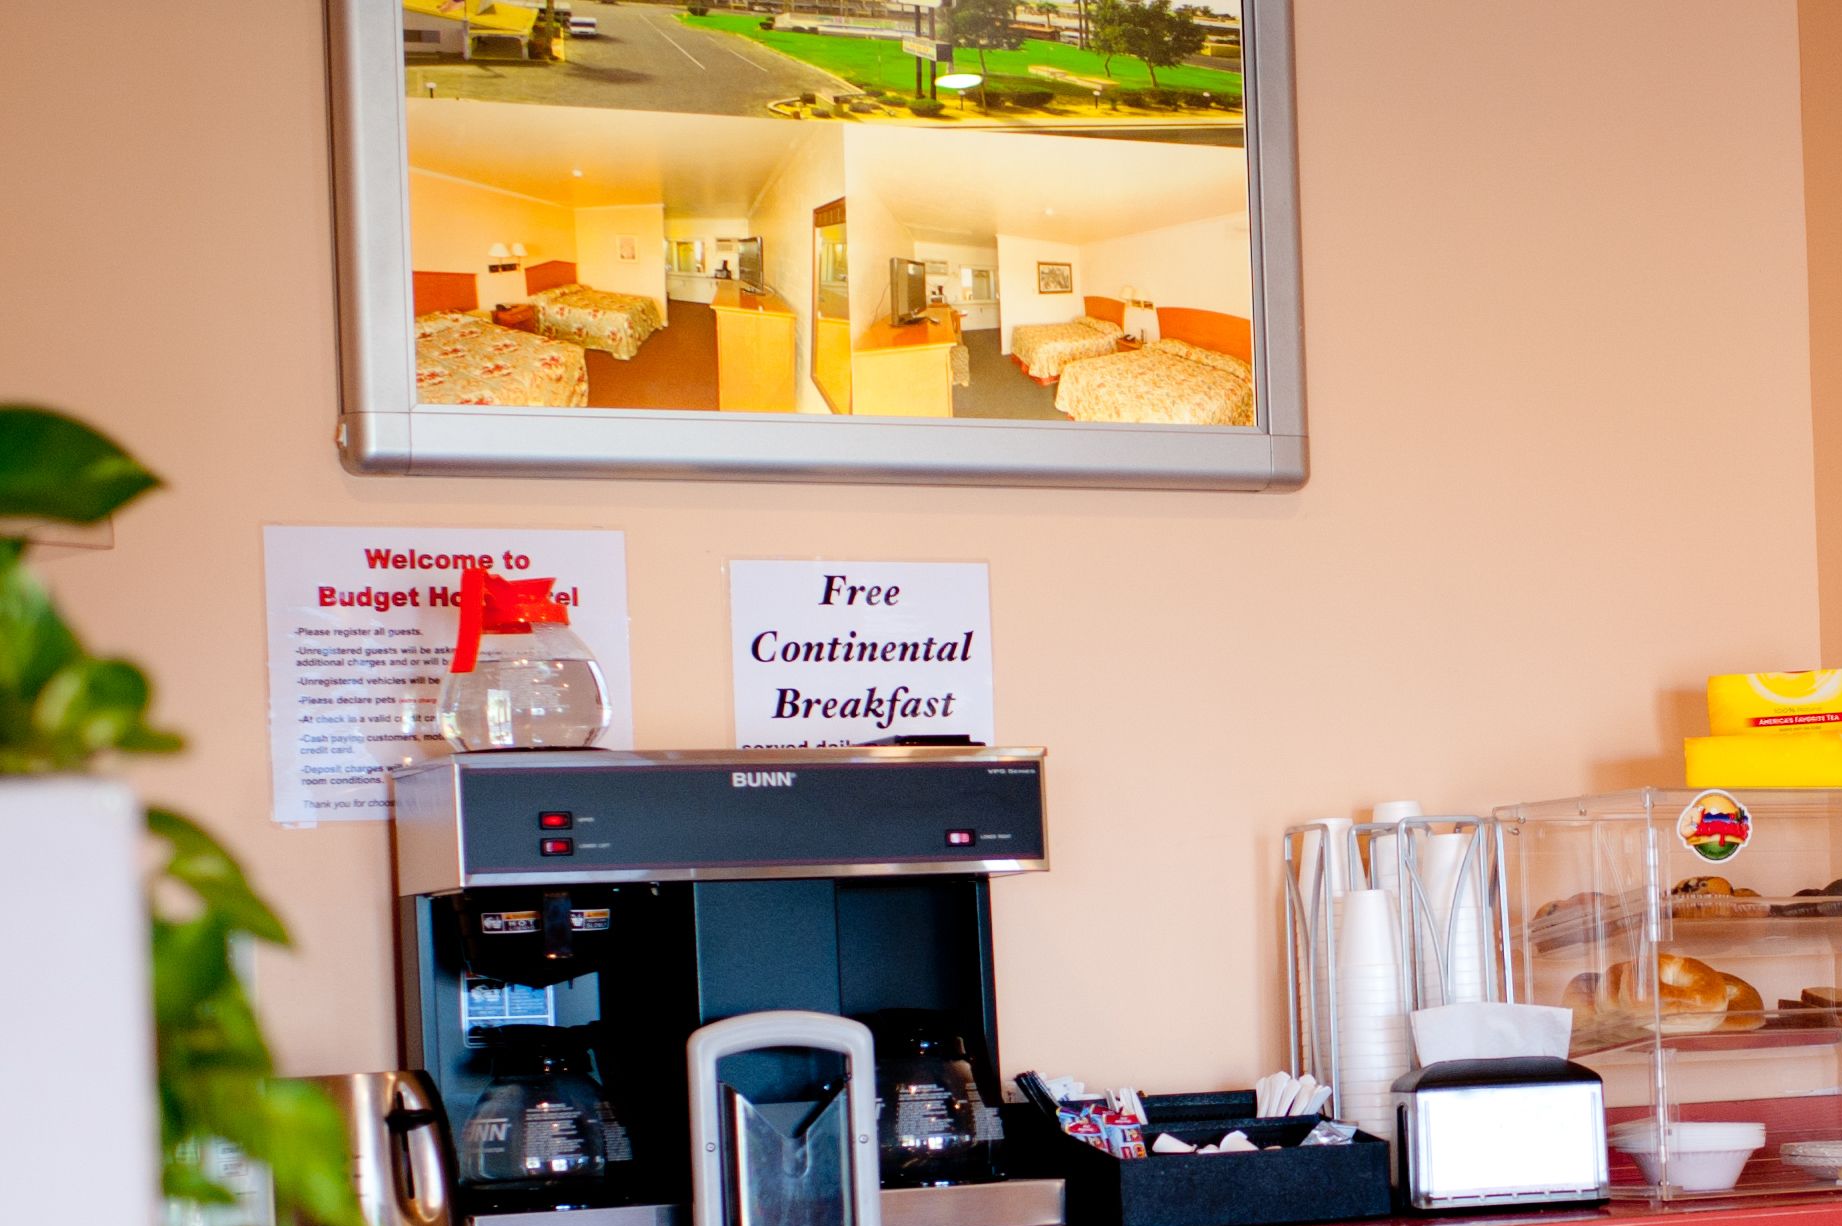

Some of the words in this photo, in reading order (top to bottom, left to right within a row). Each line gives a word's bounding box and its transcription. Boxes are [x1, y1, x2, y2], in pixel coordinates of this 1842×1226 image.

[364, 549, 494, 570] Welcome
[503, 550, 531, 570] to
[818, 574, 901, 606] Free
[318, 587, 420, 611] Budget
[333, 627, 371, 639] register
[374, 627, 385, 637] all
[750, 630, 975, 662] Continental
[365, 648, 398, 658] guests
[401, 647, 418, 656] will
[420, 647, 432, 656] be
[296, 658, 345, 667] additional
[347, 658, 386, 669] charges
[389, 658, 408, 667] and
[422, 658, 438, 667] will
[366, 677, 407, 686] vehicles
[409, 677, 425, 686] will
[428, 677, 441, 686] be
[336, 696, 373, 705] declare
[375, 697, 397, 707] pets
[771, 685, 957, 729] Breakfast
[315, 715, 345, 724] check
[368, 715, 391, 724] valid
[345, 764, 385, 776] charges
[302, 777, 328, 786] room
[303, 799, 330, 809] Thank
[333, 801, 349, 811] you
[352, 799, 365, 809] for
